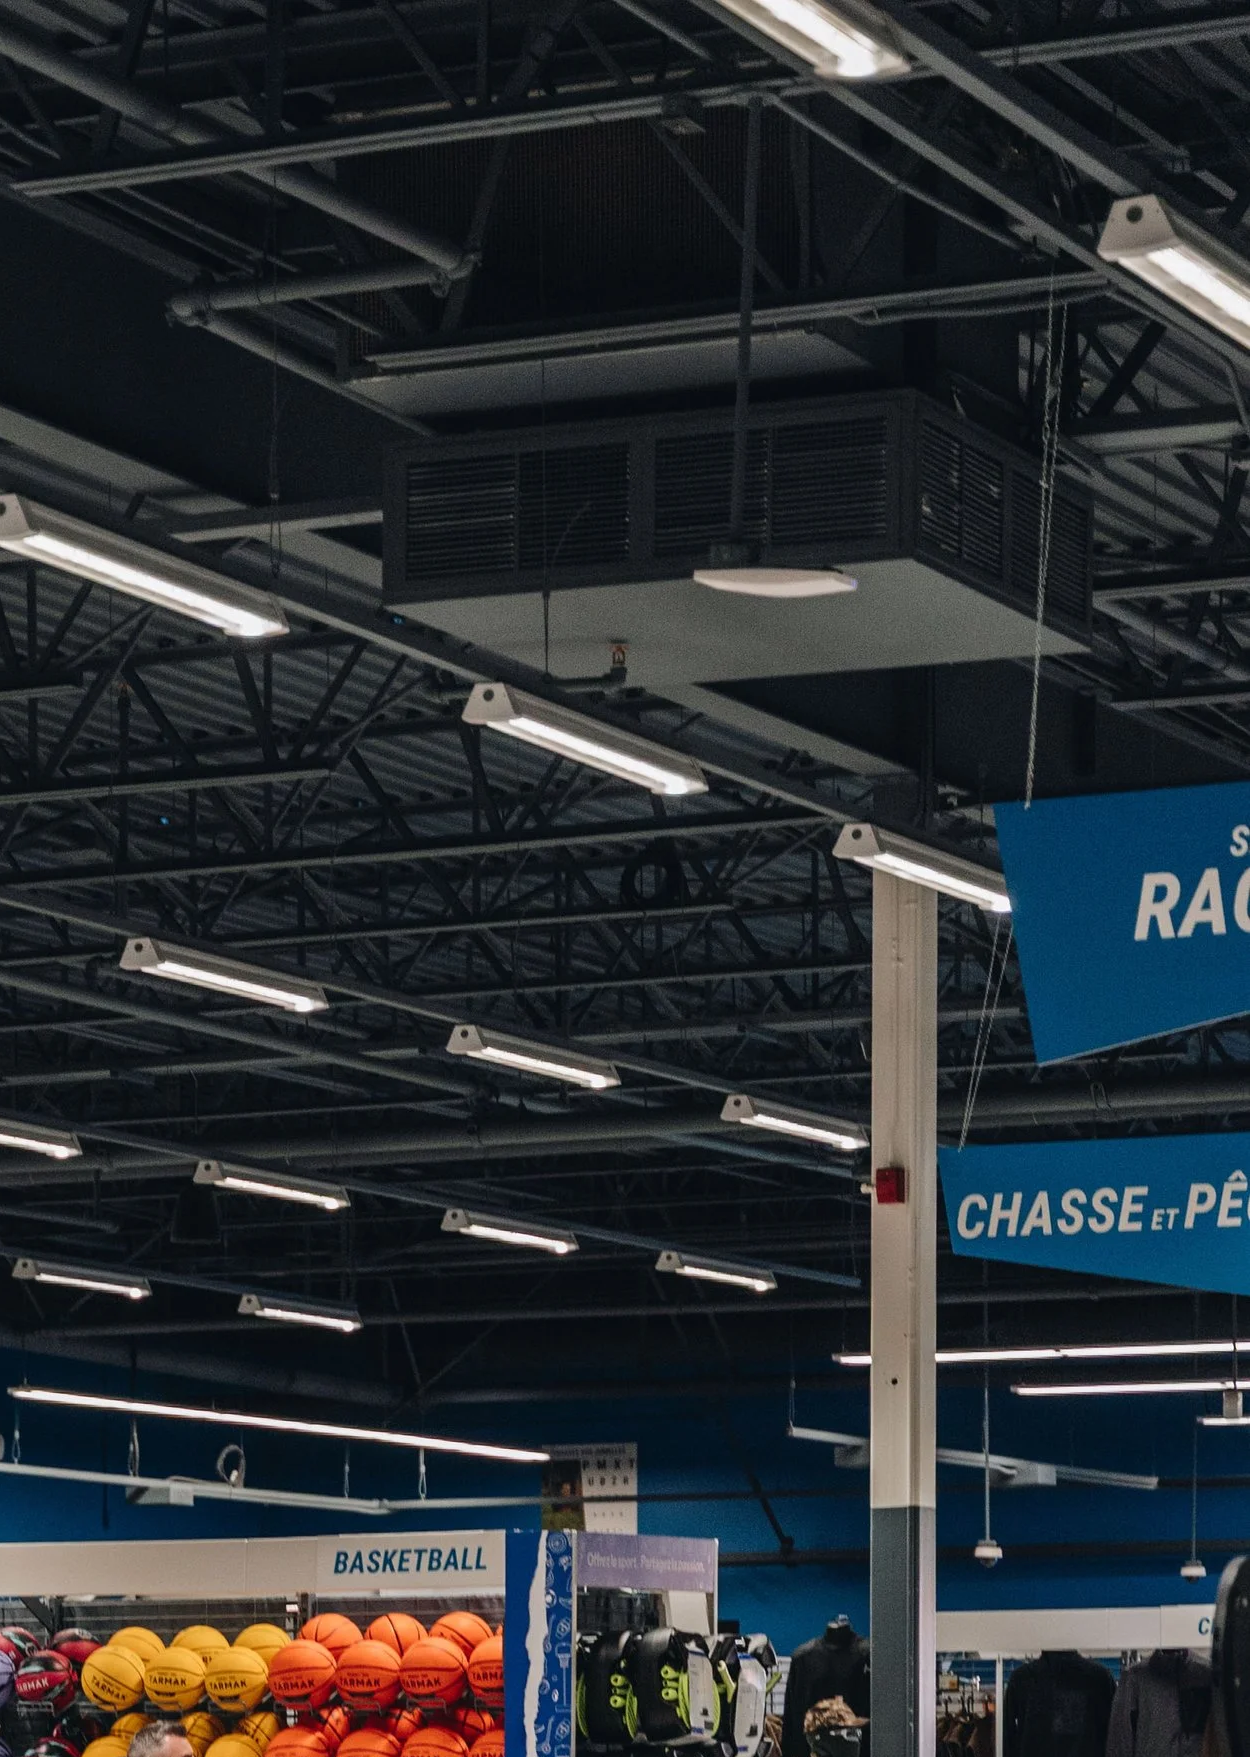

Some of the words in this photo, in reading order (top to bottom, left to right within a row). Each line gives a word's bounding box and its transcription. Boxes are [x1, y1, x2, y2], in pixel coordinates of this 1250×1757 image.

[1230, 824, 1250, 857] S
[957, 1186, 1149, 1240] CHASSE
[1151, 1207, 1180, 1231] ET
[1184, 1169, 1250, 1230] PÊ
[334, 1546, 487, 1574] BASKETBALL
[150, 1675, 187, 1687] TARMAK
[210, 1679, 247, 1690] TARMAK
[274, 1679, 315, 1691] TARMAK
[339, 1673, 381, 1687] TARMAK
